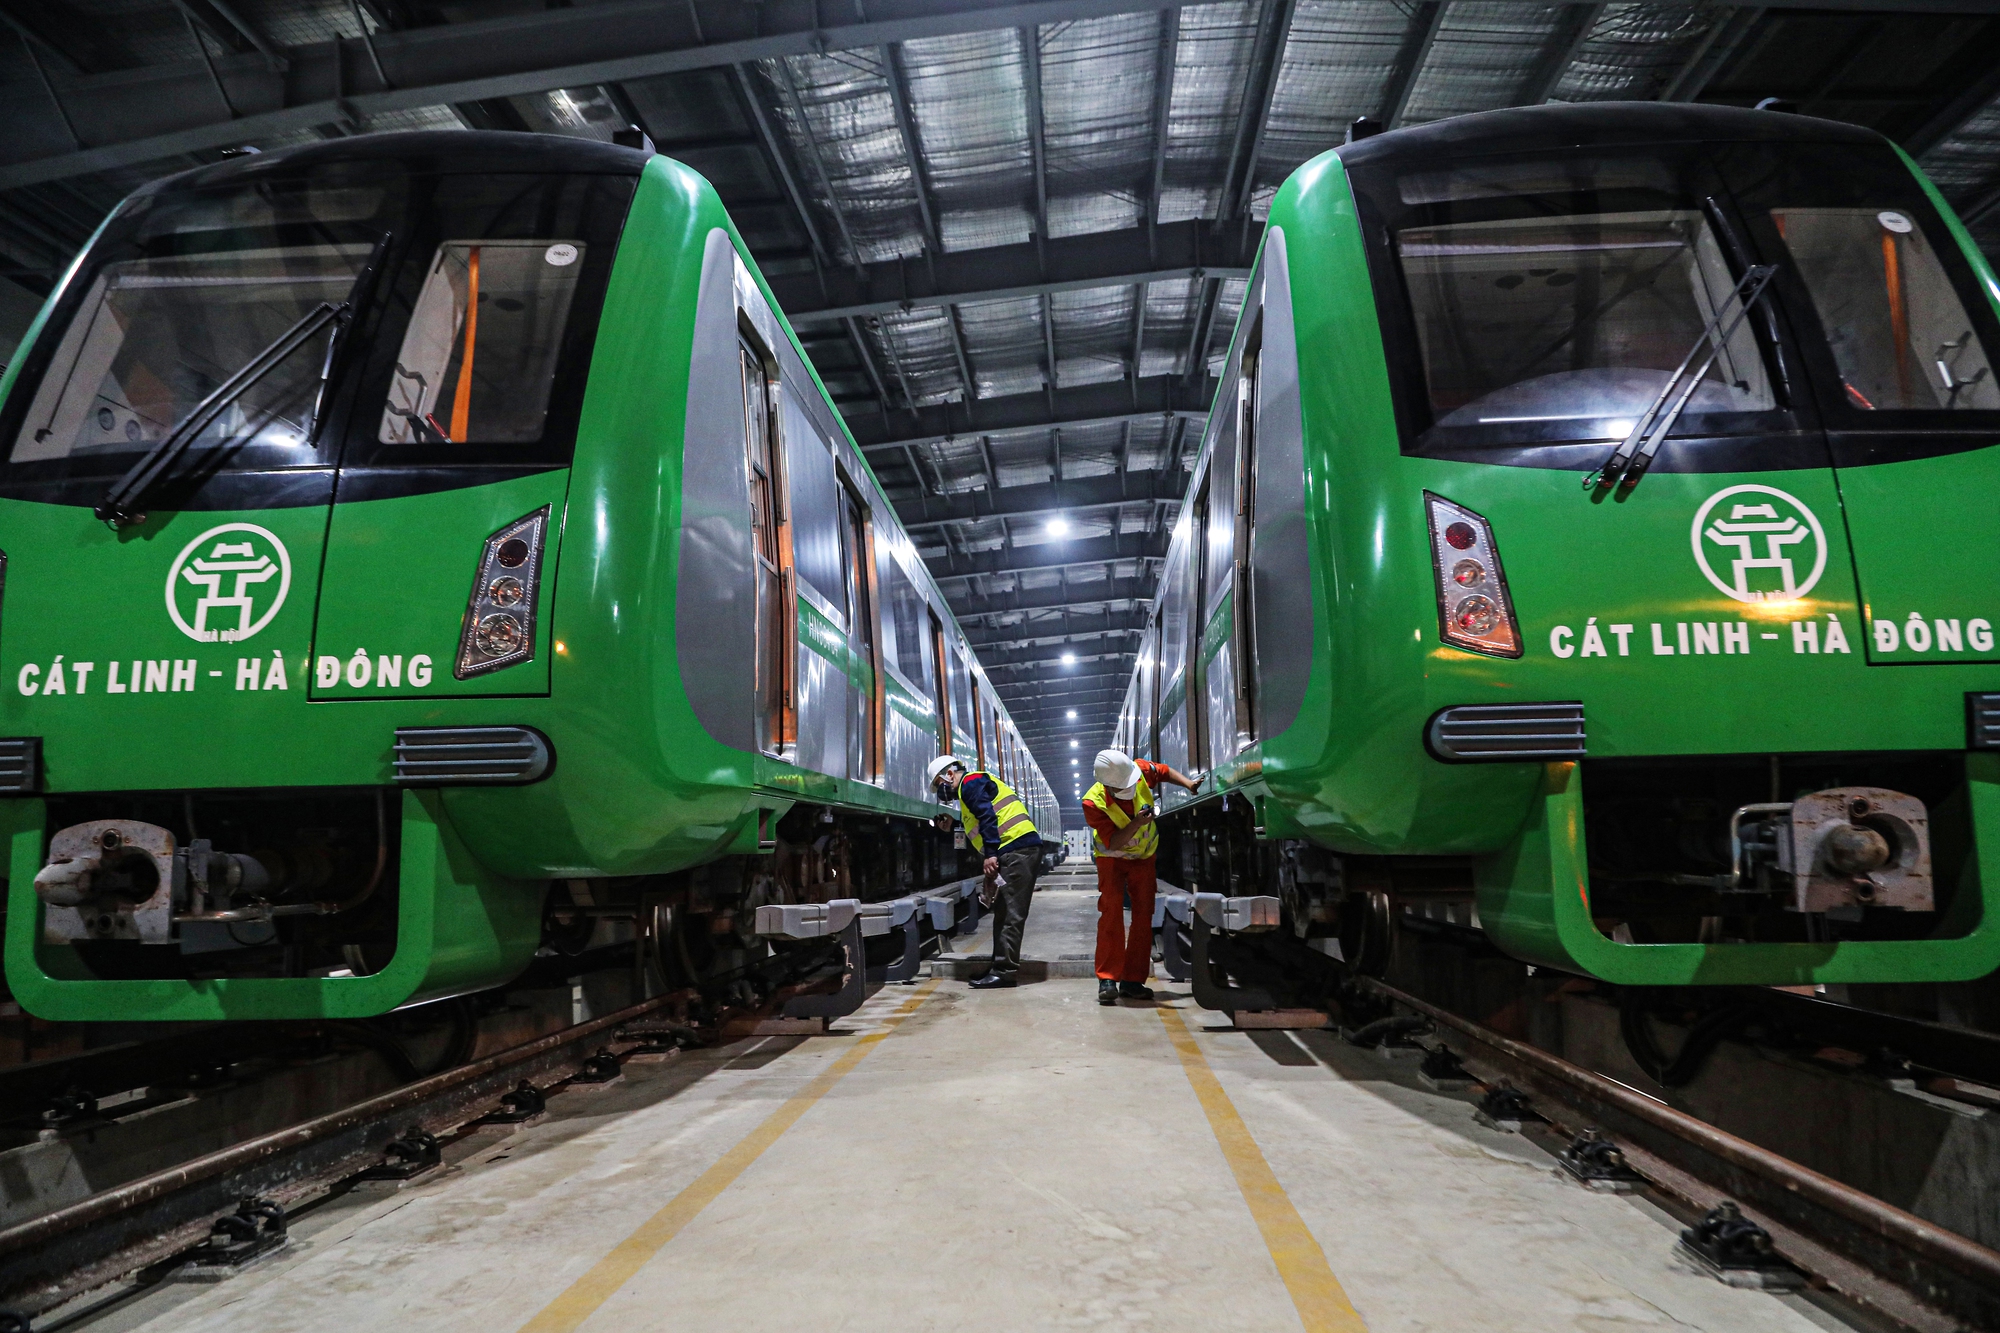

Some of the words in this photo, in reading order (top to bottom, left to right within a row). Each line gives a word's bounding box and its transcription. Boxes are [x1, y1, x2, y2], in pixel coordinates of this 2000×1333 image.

[1549, 616, 1634, 658] CÁT
[1650, 622, 1750, 656] LINH
[1791, 613, 1851, 654] HÀ
[1873, 611, 1994, 653] ĐÔNG
[18, 654, 94, 696] CÁT
[107, 659, 197, 694] LINH
[235, 649, 288, 691] HÀ
[316, 647, 433, 689] ĐÔNG
